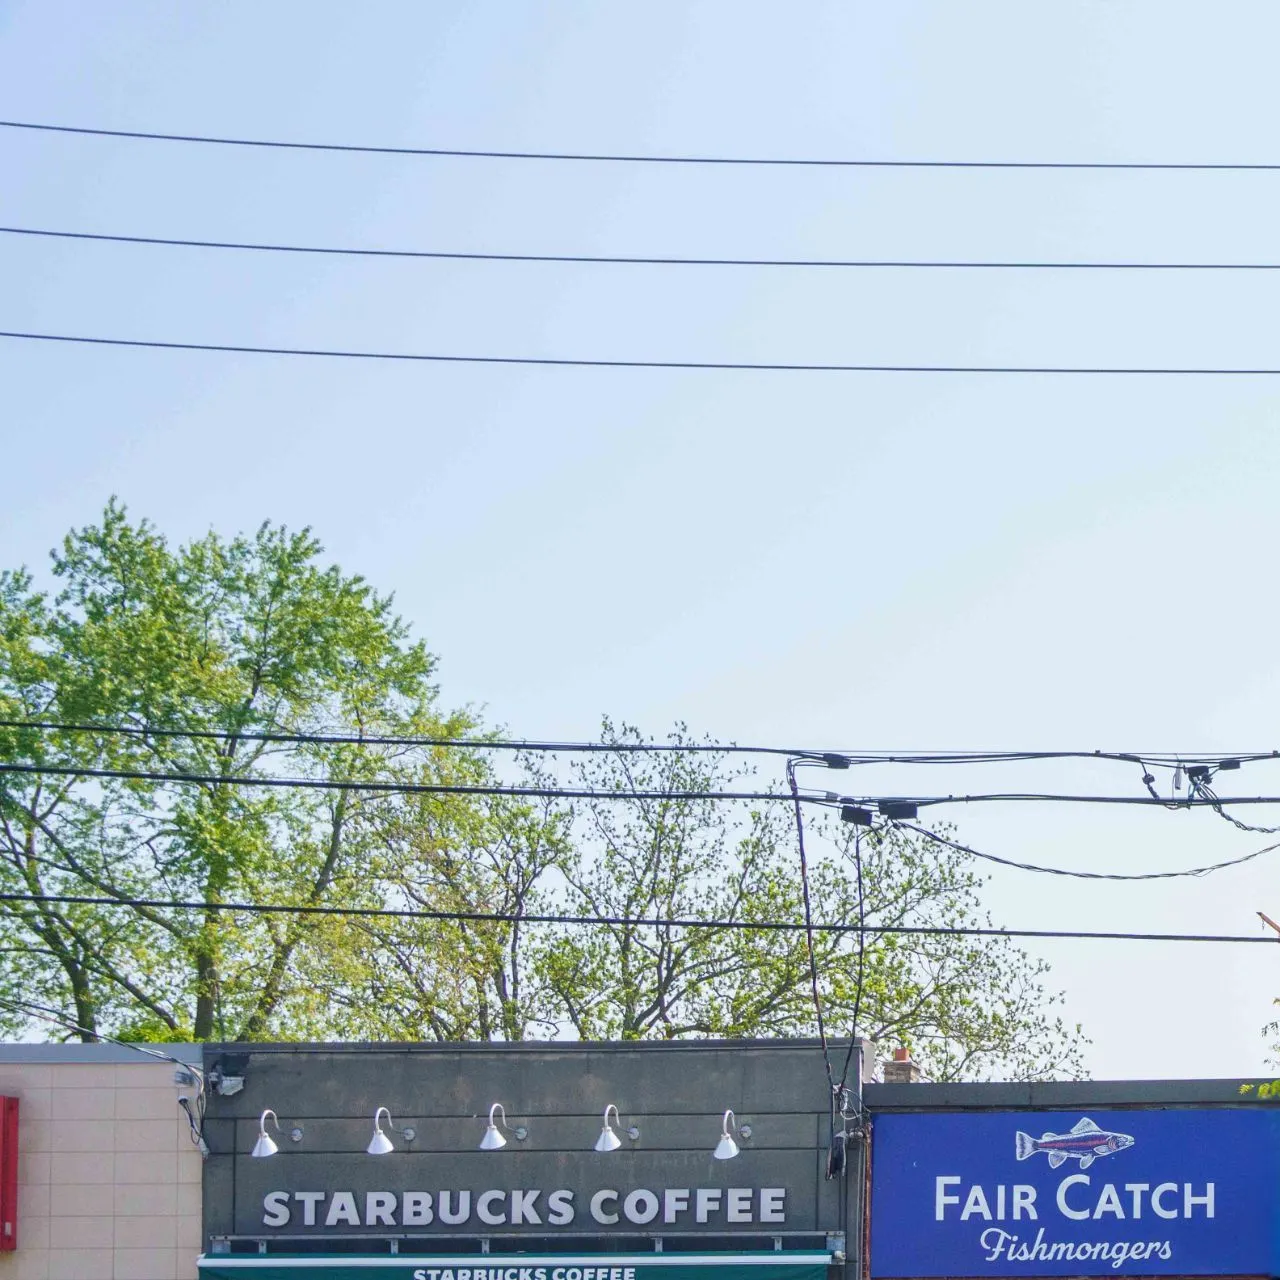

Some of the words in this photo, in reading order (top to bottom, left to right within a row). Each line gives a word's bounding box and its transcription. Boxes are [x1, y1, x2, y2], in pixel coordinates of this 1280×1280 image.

[262, 1189, 575, 1226] STARBUCKS
[590, 1188, 786, 1225] COFFEE
[935, 1175, 1038, 1221] FAIR
[1056, 1174, 1215, 1220] CATCH
[979, 1227, 1172, 1268] Fishmongers
